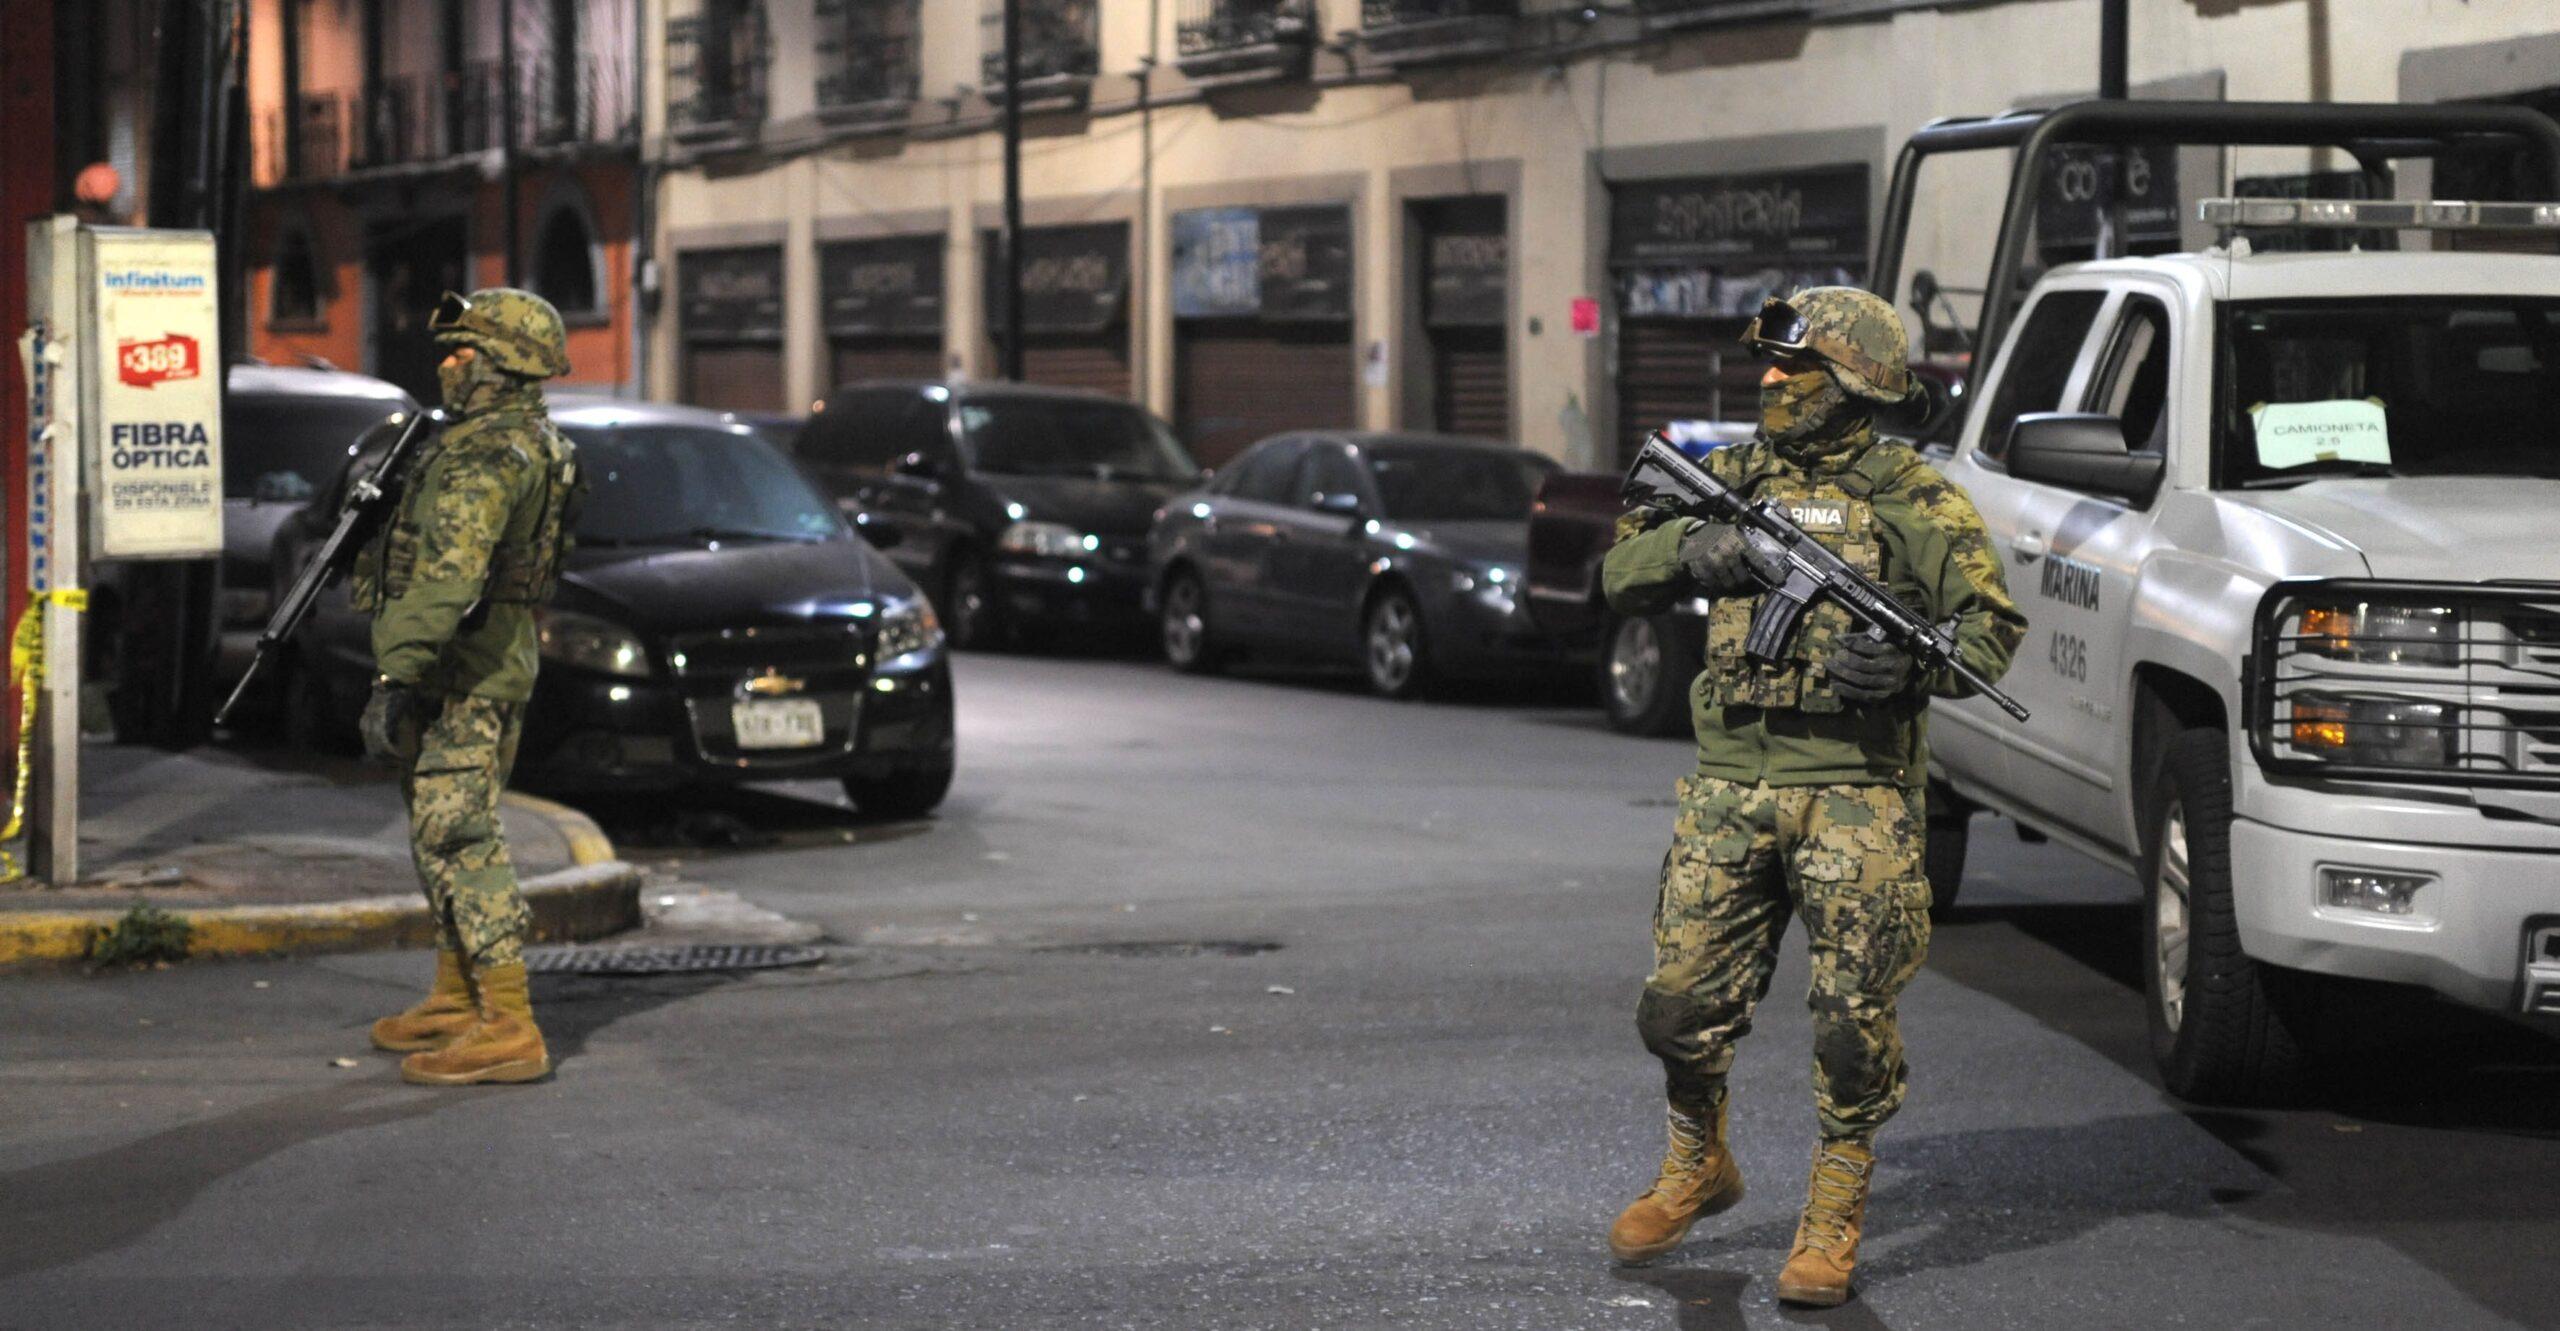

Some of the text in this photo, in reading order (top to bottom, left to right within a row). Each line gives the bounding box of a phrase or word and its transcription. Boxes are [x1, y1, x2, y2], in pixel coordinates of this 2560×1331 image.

[104, 271, 204, 288] infinitum
[111, 422, 208, 446] FIBRA
[2274, 422, 2379, 436] CAMIONETA
[112, 447, 209, 469] ÓPTICA
[1790, 507, 1842, 525] RINA
[2041, 556, 2100, 612] MARINA
[2049, 629, 2087, 683] 4326
